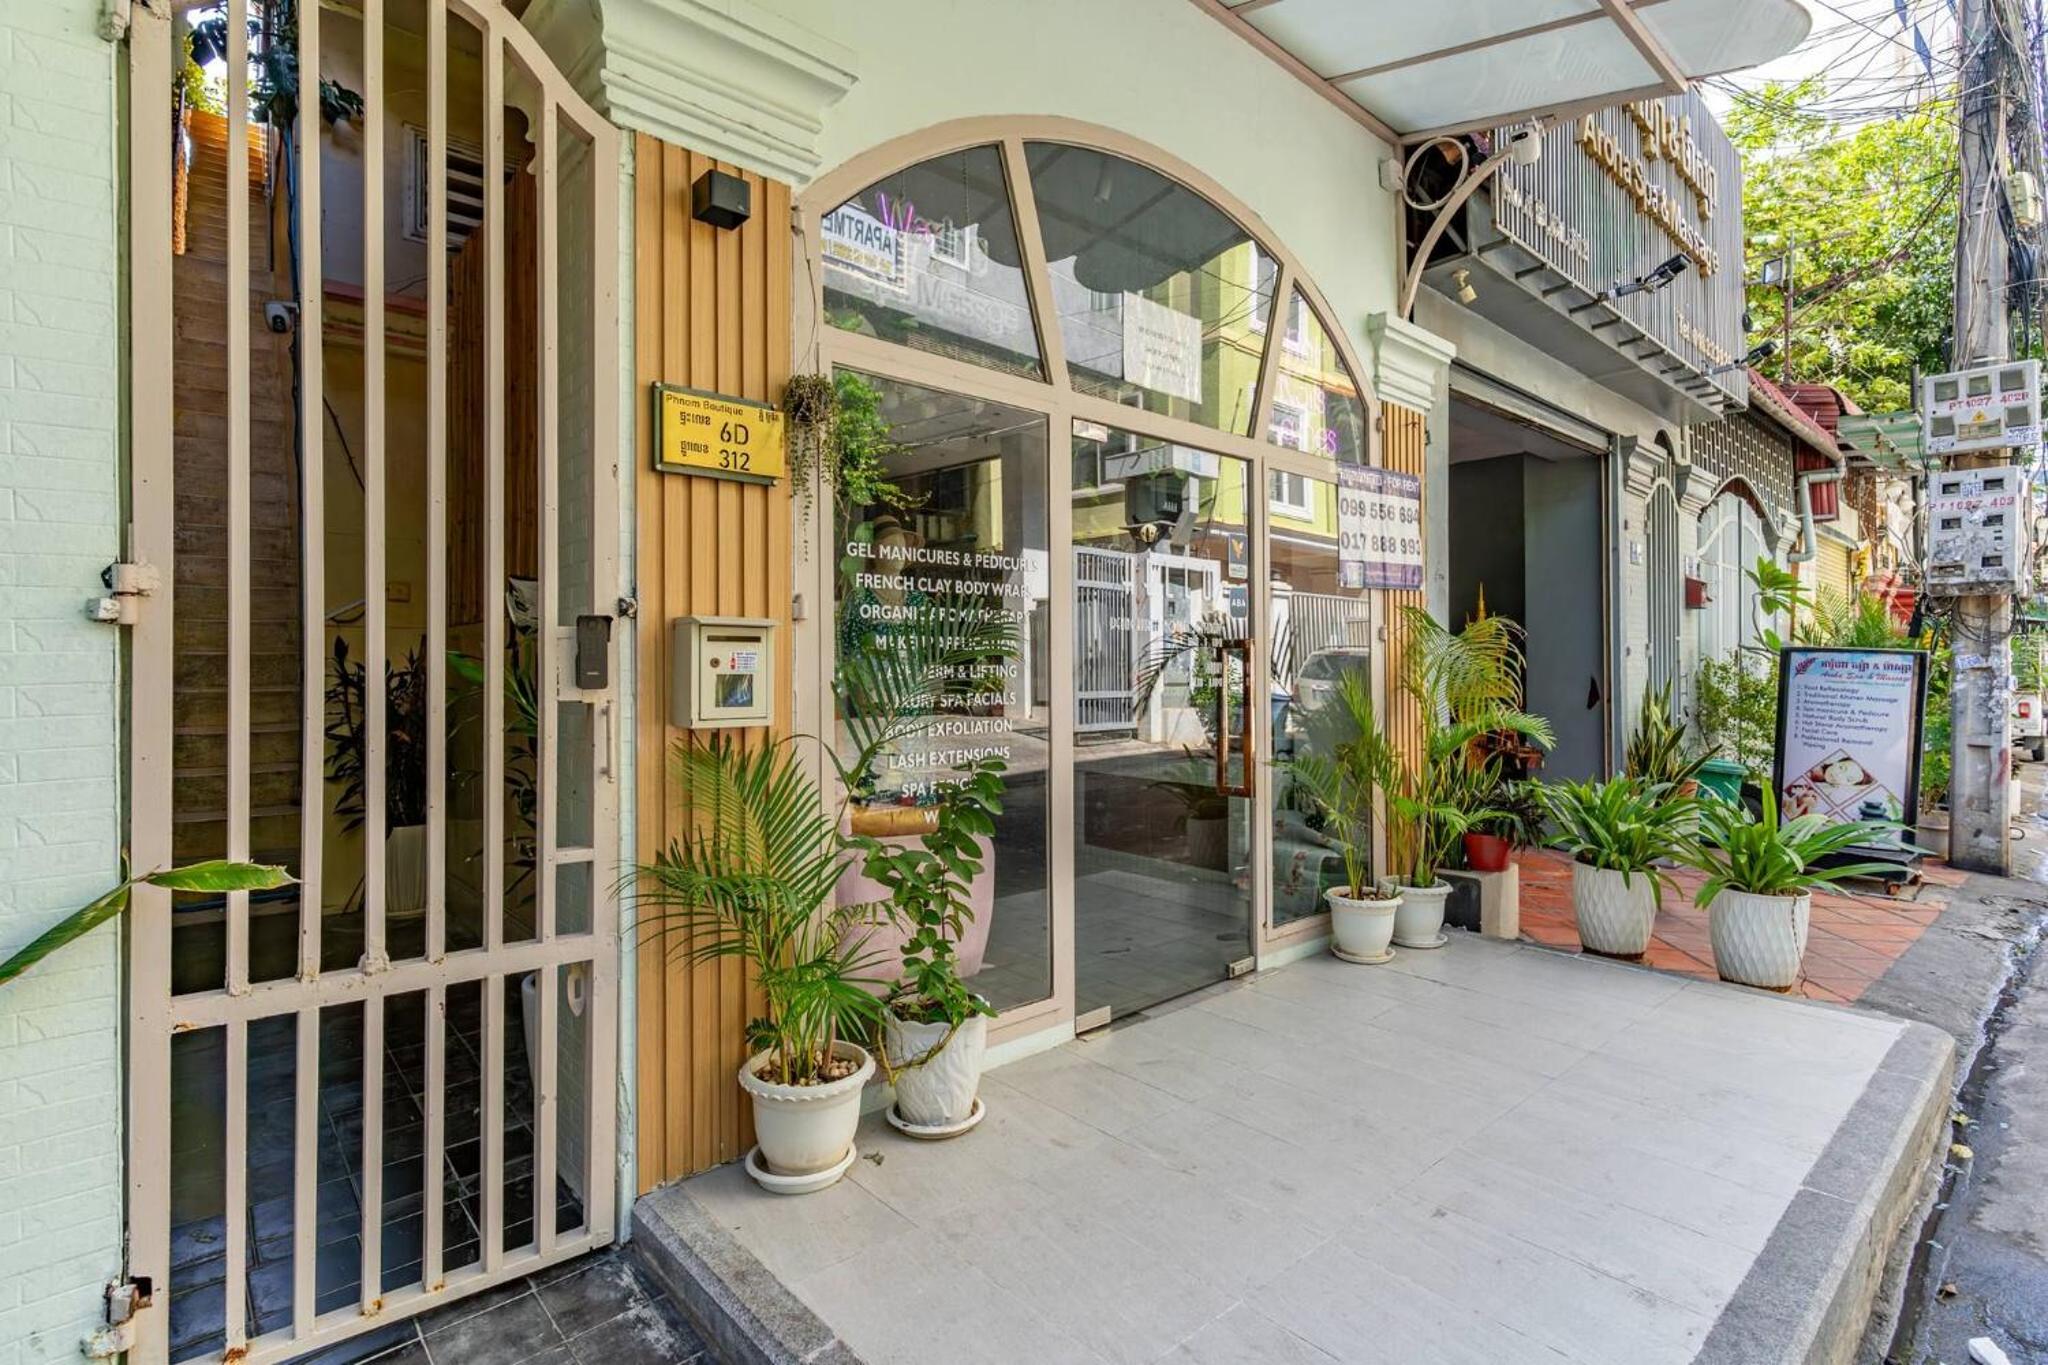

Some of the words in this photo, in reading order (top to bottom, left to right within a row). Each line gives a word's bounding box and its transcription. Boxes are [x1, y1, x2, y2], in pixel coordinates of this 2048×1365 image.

[666, 394, 701, 409] Phnom
[703, 401, 744, 417] Boutique
[720, 421, 749, 446] 6D
[719, 449, 750, 472] 312
[1340, 531, 1367, 551] 017
[846, 542, 876, 558] GEL
[879, 545, 960, 566] MANICURES
[963, 553, 972, 567] &
[855, 573, 914, 591] FRENCH
[918, 577, 952, 593] CLAY
[955, 579, 990, 595] BODY
[1232, 599, 1246, 608] ABA
[957, 664, 970, 679] &
[970, 664, 1017, 679] LIFTING
[940, 694, 964, 708] SPA
[967, 691, 1017, 707] FACIALS
[928, 718, 1013, 737] EXFOLIATION
[889, 753, 926, 769] LASH
[929, 746, 1010, 766] EXTENSIONS
[901, 783, 926, 798] SPA
